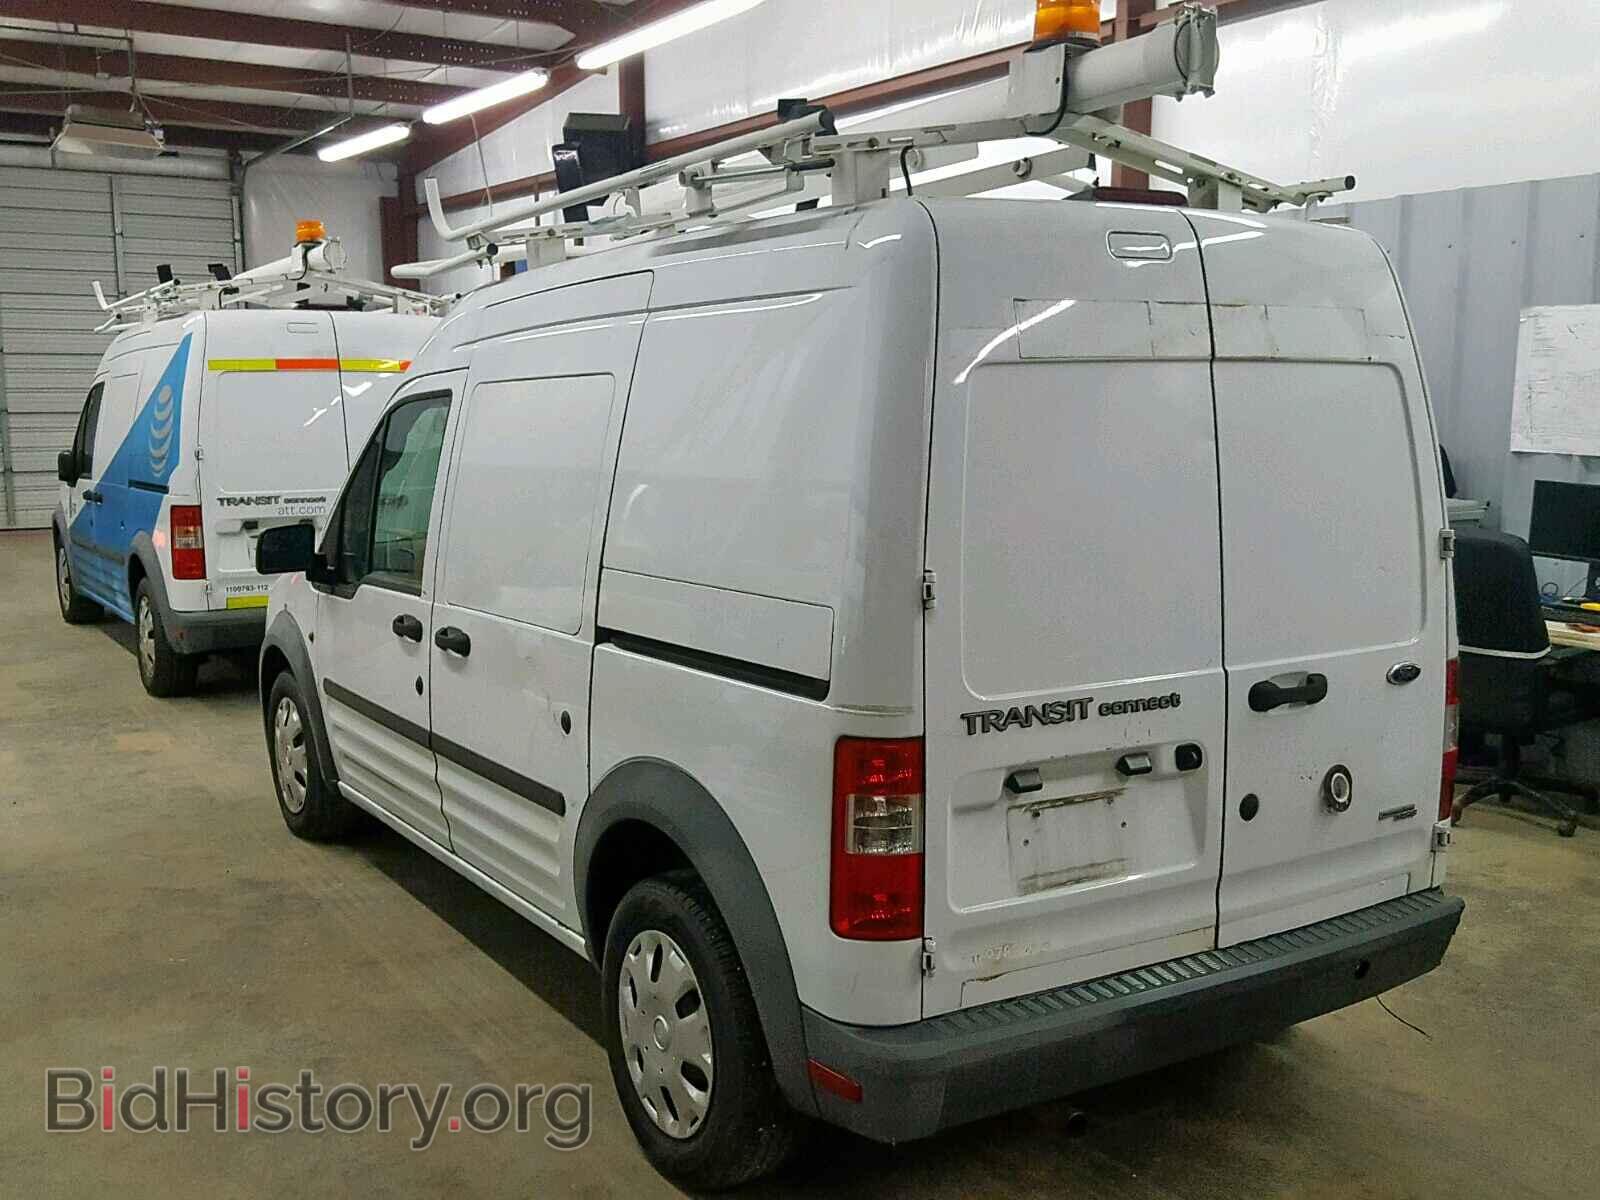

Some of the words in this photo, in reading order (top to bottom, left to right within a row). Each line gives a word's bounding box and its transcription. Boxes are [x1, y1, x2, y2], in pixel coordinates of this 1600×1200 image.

[217, 495, 281, 507] TRANSIT
[960, 696, 1094, 736] TRANSIT
[1098, 692, 1182, 717] connect
